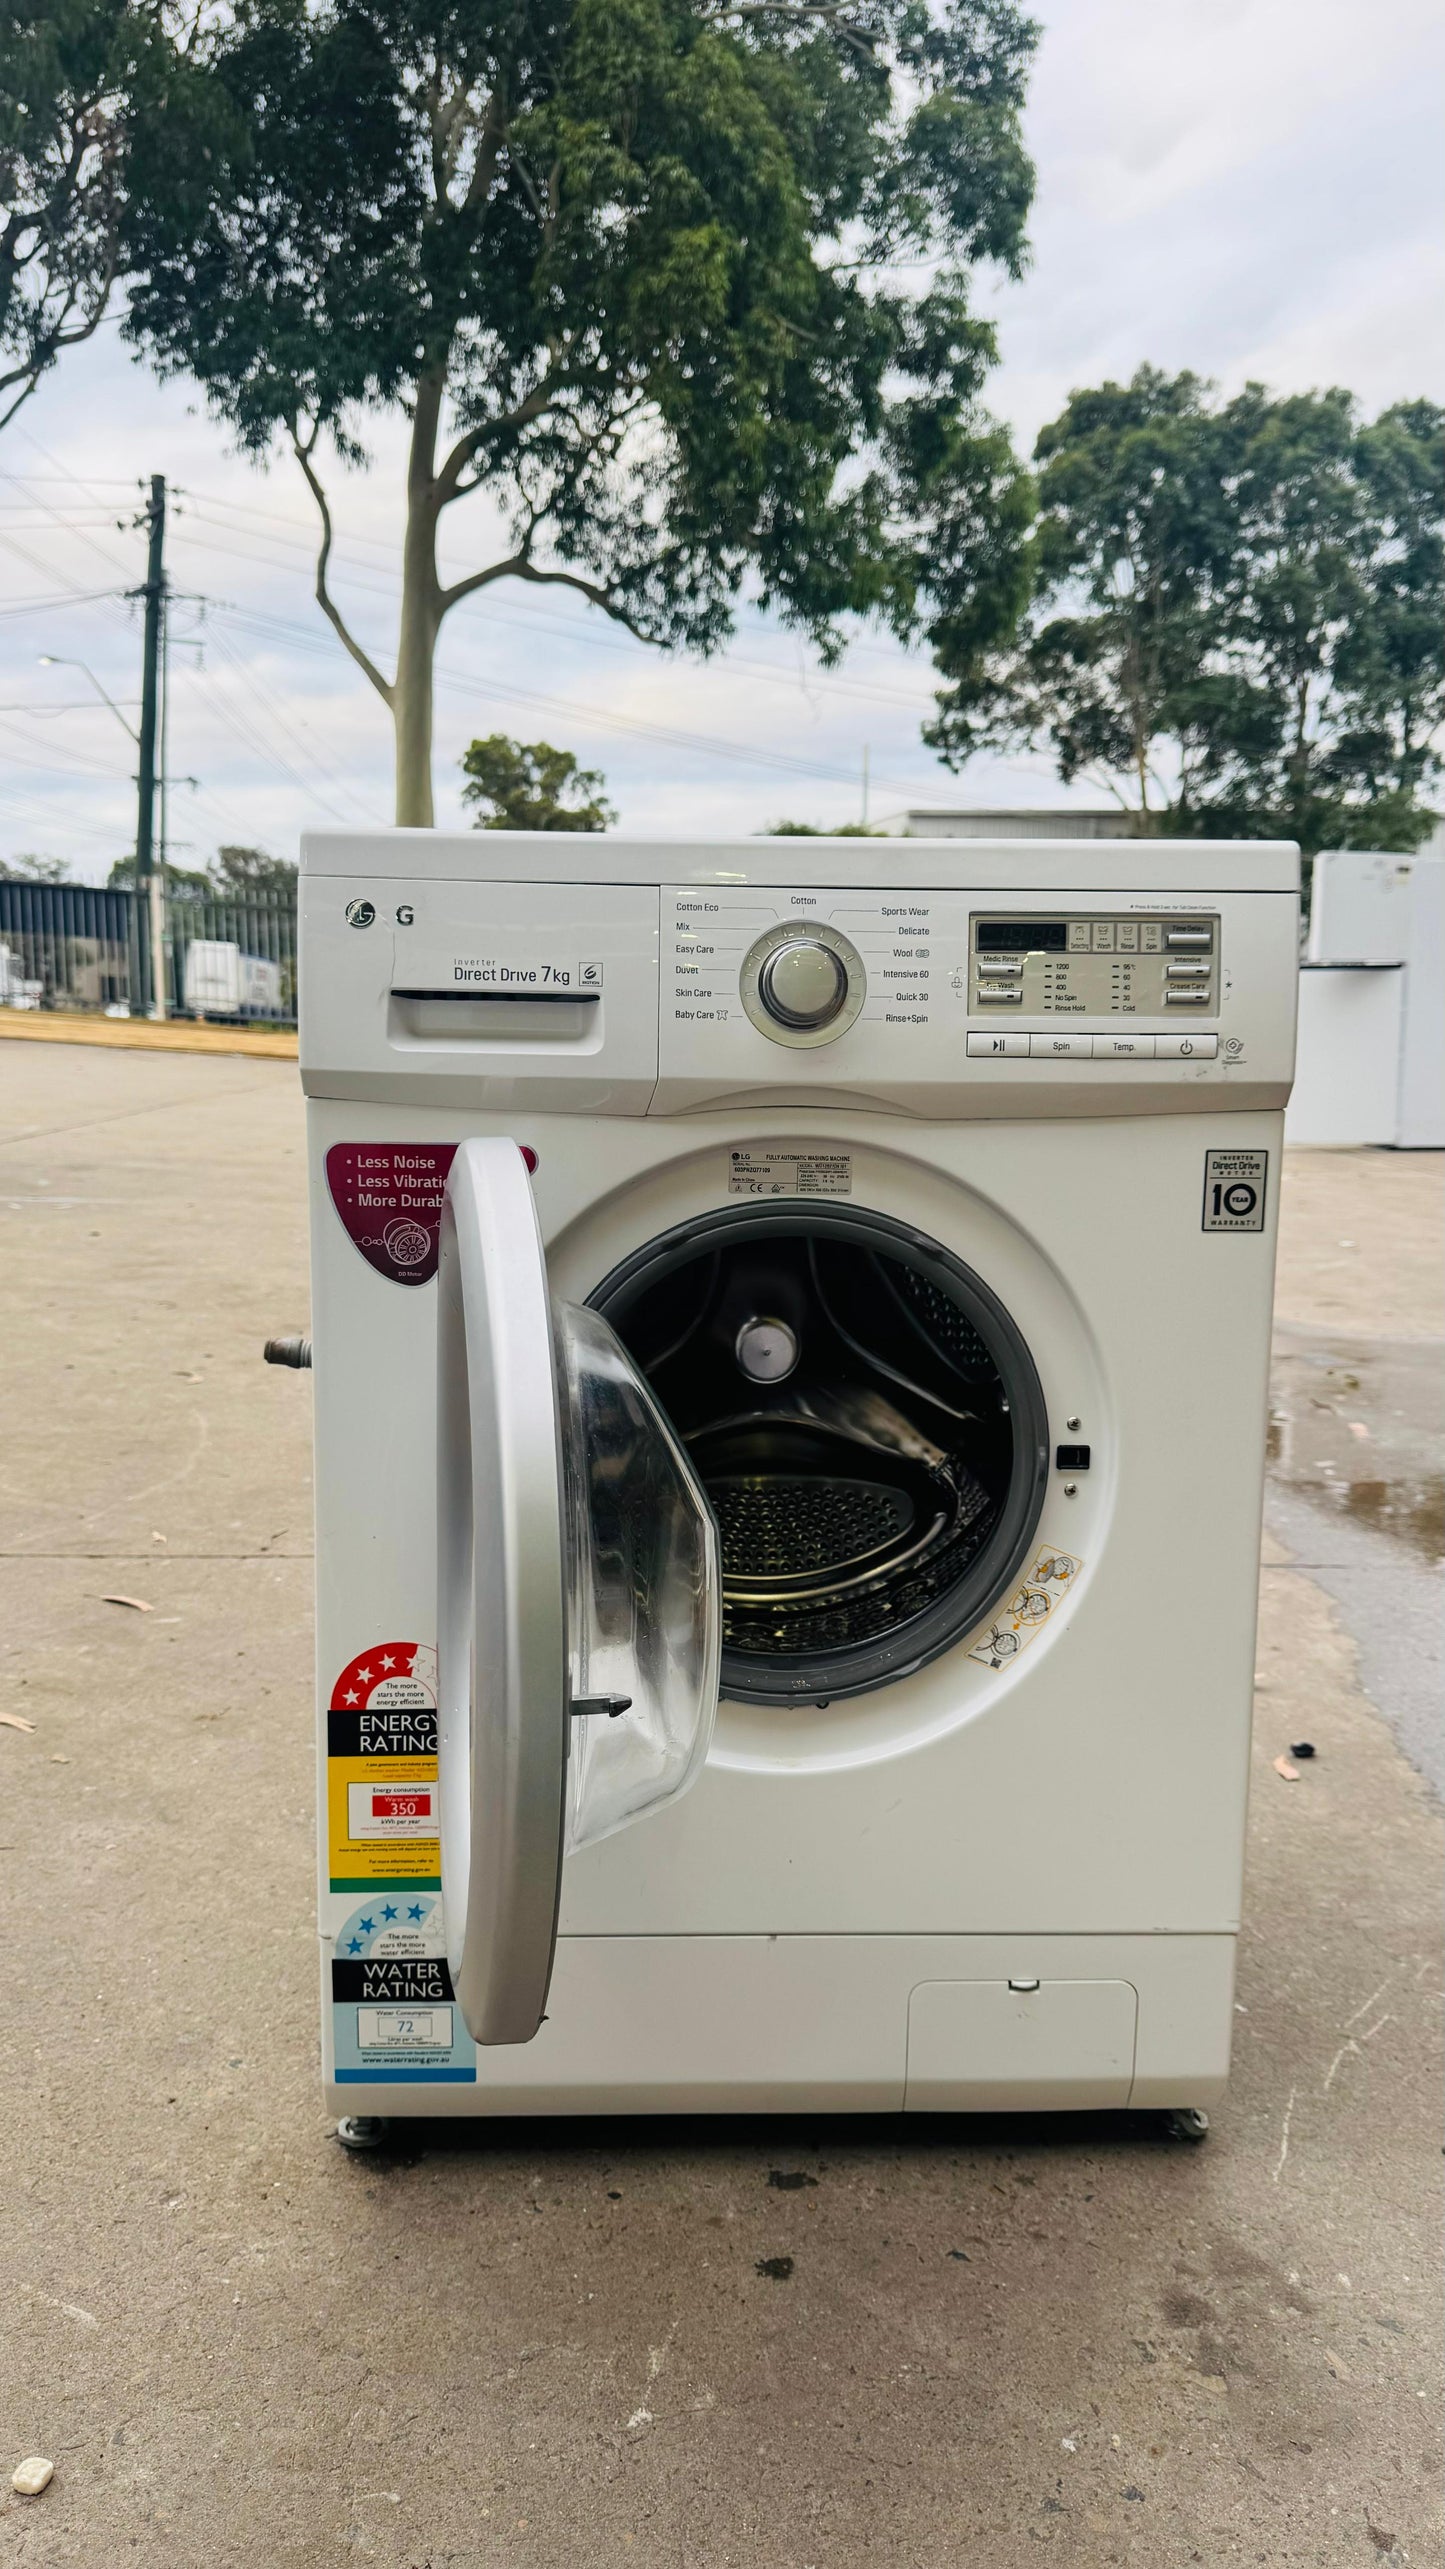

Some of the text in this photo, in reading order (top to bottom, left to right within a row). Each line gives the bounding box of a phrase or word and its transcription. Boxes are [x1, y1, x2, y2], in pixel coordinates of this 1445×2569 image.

[791, 896, 817, 904] Cotton
[676, 903, 719, 912] Cotton Eco
[881, 907, 930, 916] Sports Wear
[396, 905, 414, 926] G
[676, 922, 690, 930] Mix
[898, 927, 930, 935] Delicate
[676, 945, 714, 954] Easy Care
[893, 949, 912, 957] Wool
[455, 967, 496, 981] Direct
[501, 968, 537, 982] Drive
[676, 966, 699, 974] Duvet
[883, 970, 929, 978] Intensive 60
[676, 989, 712, 997] Skin Care
[896, 993, 929, 1001] Quick 30
[675, 1010, 714, 1020] Baby Care
[886, 1014, 928, 1024] Rinse+Spin
[1053, 1042, 1070, 1051] Spin
[358, 1154, 436, 1168] Less Noise
[1213, 1161, 1260, 1170] Direct Drive
[358, 1174, 390, 1187] Less
[358, 1194, 397, 1207] More
[390, 1802, 416, 1815] 350
[364, 1963, 441, 1979] WATER
[363, 1981, 443, 1998] RATING
[397, 2020, 414, 2032] 72
